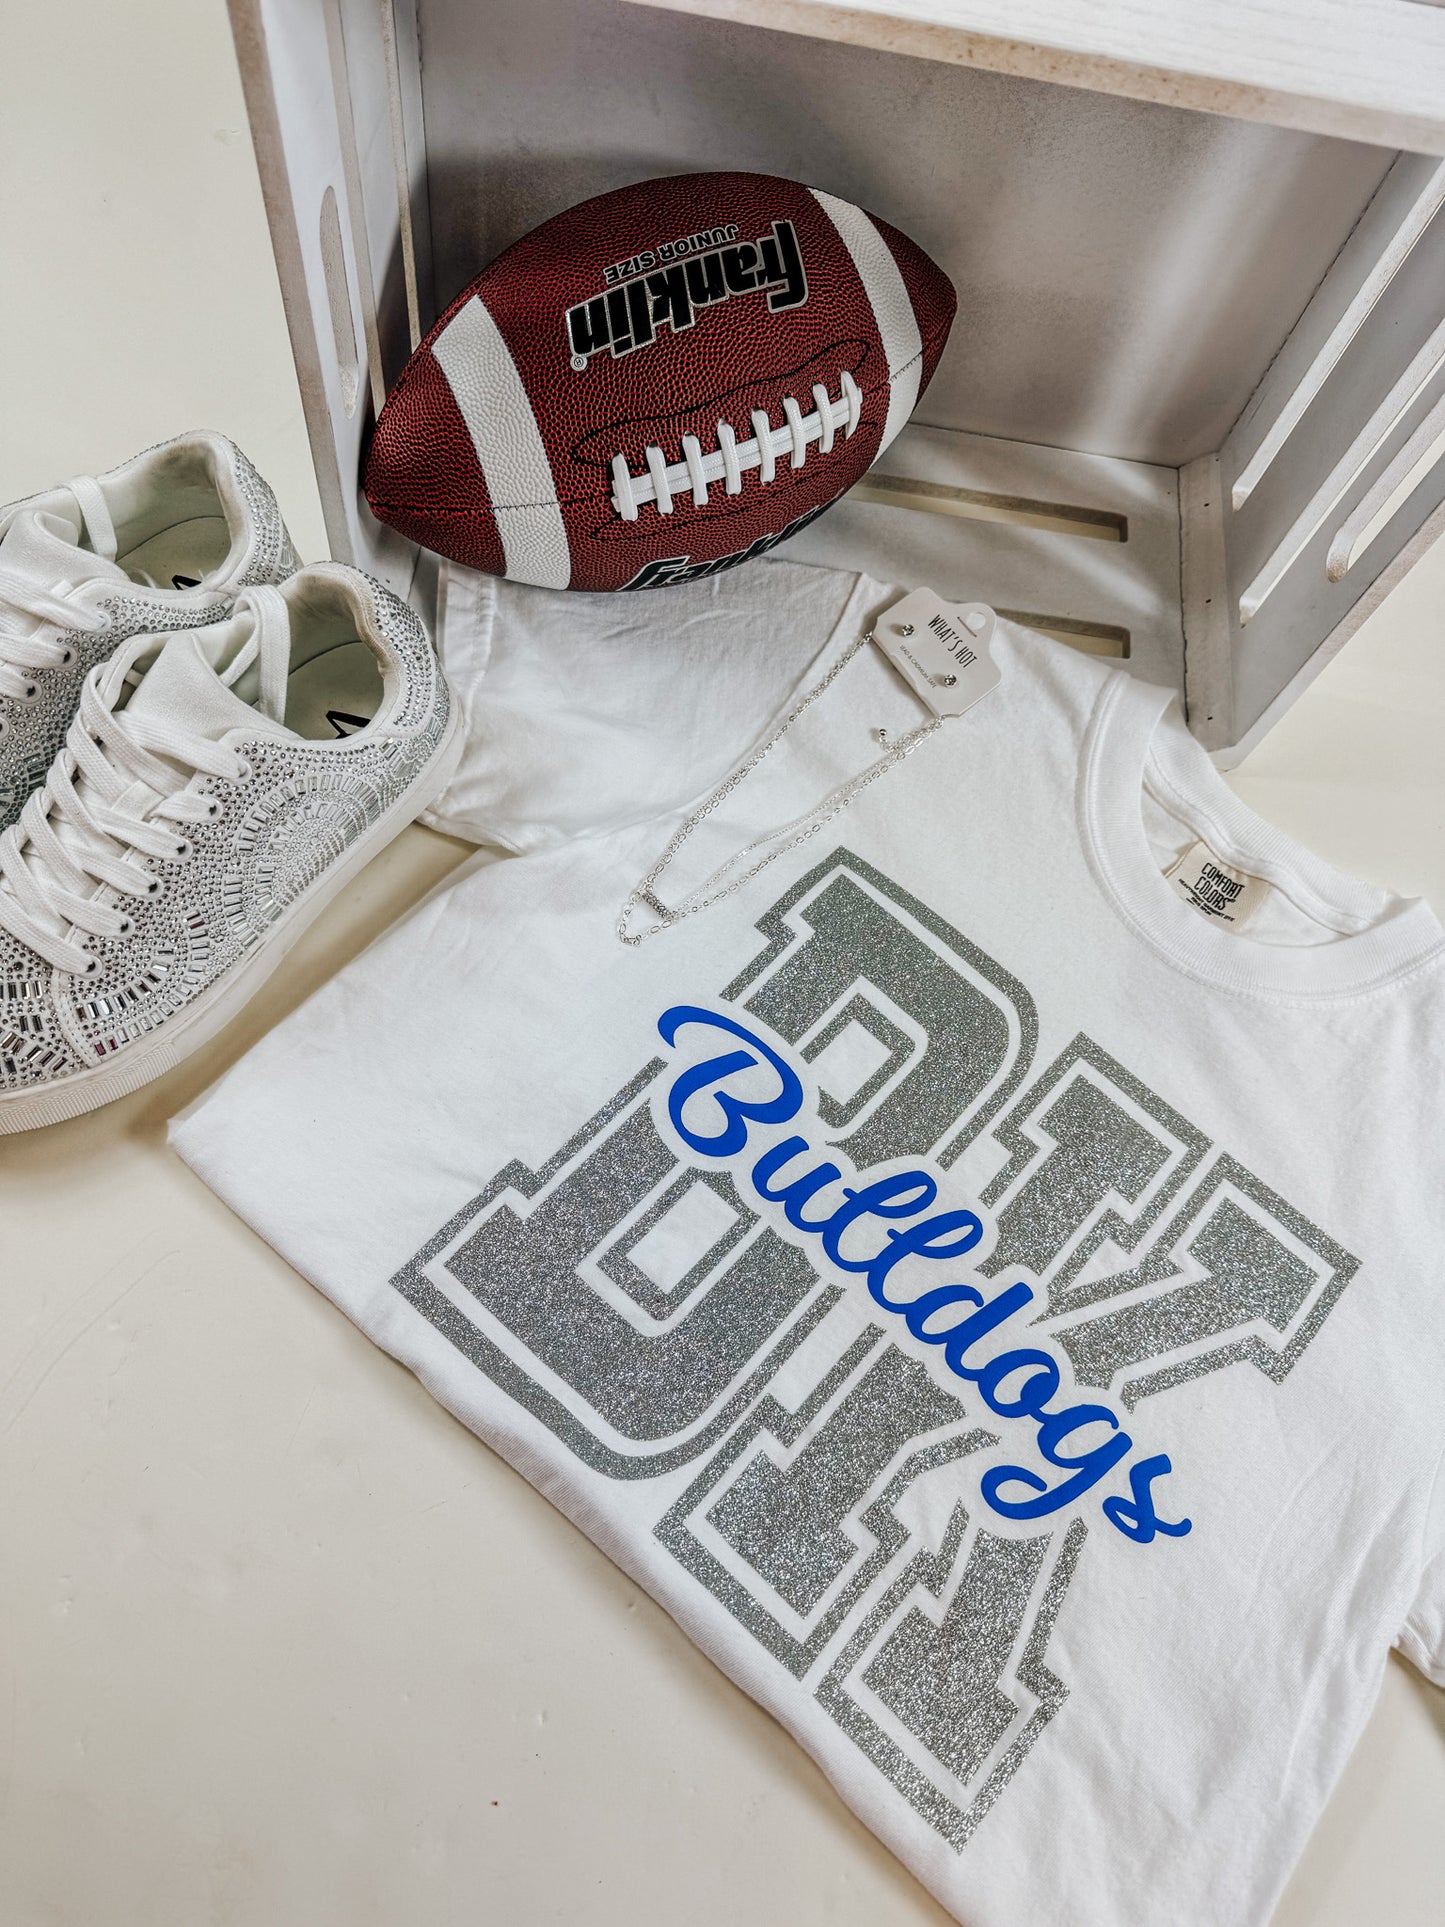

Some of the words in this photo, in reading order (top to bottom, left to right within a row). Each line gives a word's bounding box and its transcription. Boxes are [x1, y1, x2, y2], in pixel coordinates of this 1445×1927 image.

[656, 224, 739, 262] JUNIOR
[603, 250, 656, 285] SIZE
[565, 219, 809, 359] franklin
[928, 614, 963, 652] WHAT'S
[954, 646, 977, 668] HOT
[1194, 876, 1227, 910] COLORS
[1201, 862, 1245, 898] COMFORT
[658, 1006, 1192, 1543] Bulldogs
